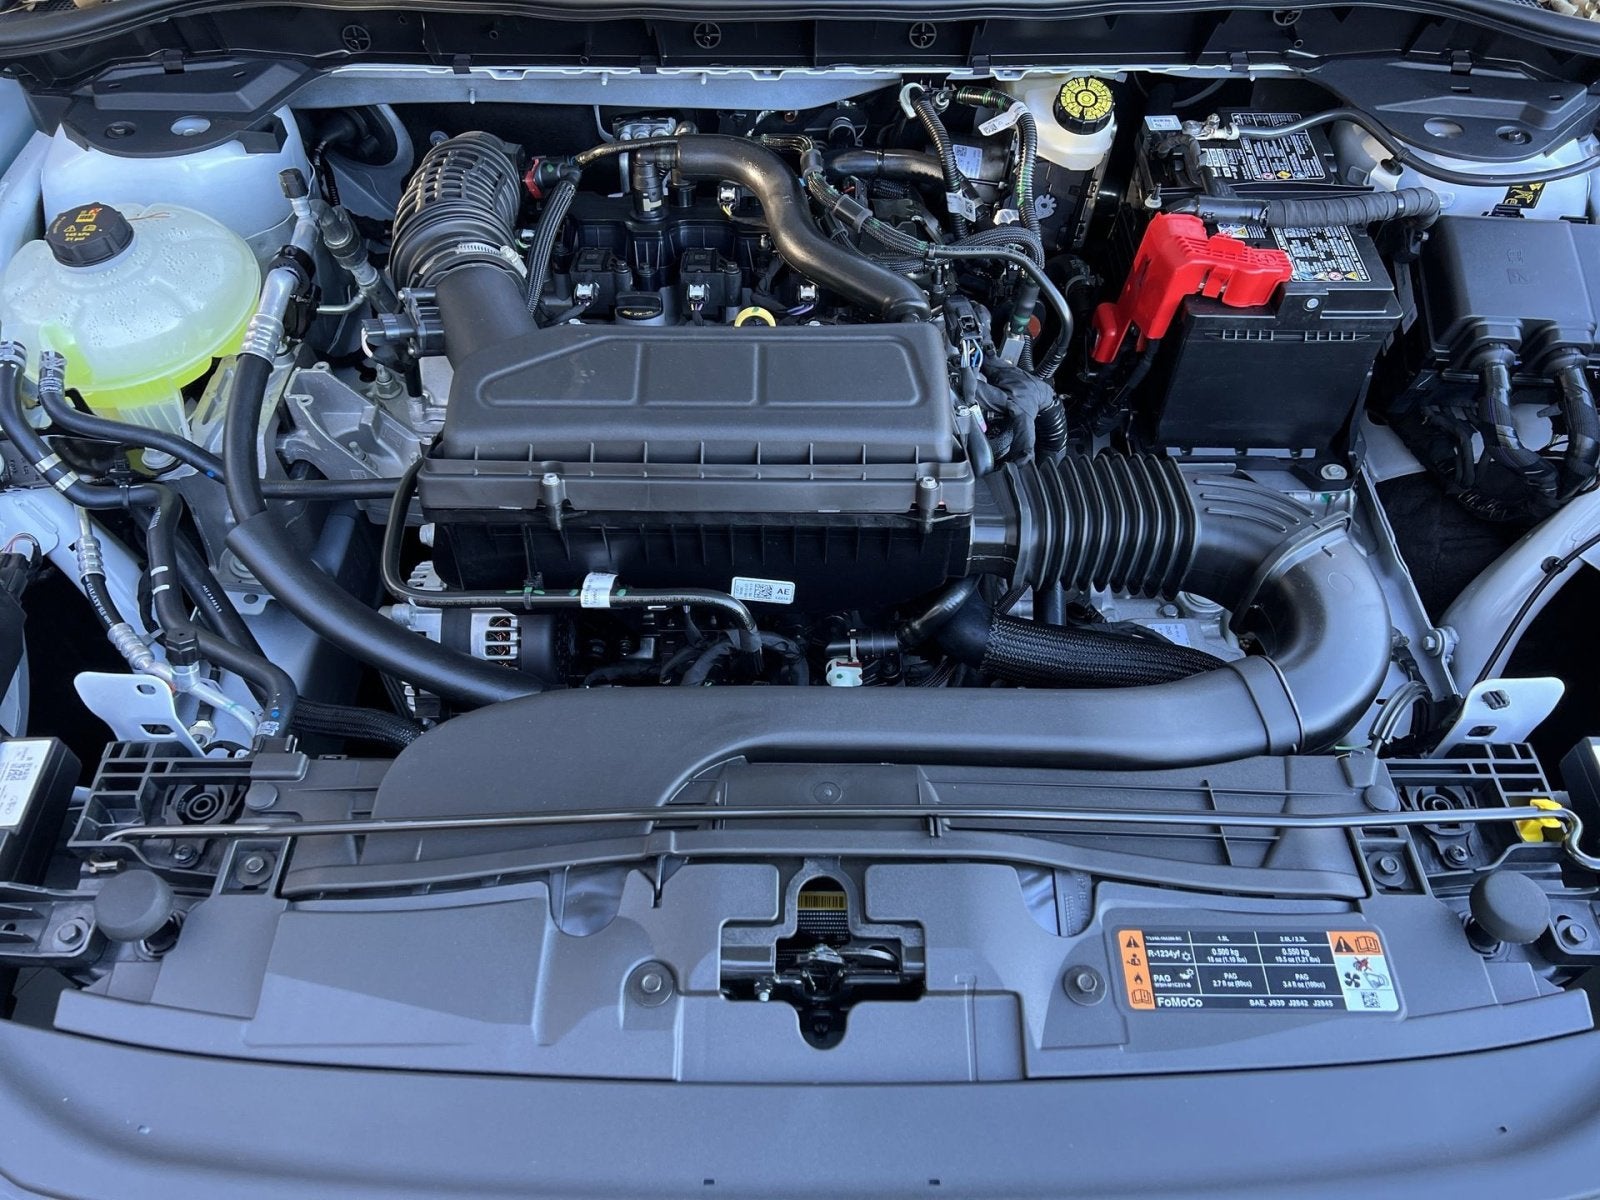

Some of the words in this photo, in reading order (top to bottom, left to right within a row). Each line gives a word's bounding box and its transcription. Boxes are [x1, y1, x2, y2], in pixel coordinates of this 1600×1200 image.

[86, 582, 102, 607] GALAXY
[777, 588, 791, 596] AE
[1147, 949, 1181, 959] R-1234yf
[1230, 948, 1240, 957] kg
[1300, 948, 1310, 957] kg
[1153, 974, 1172, 982] PAG
[1223, 972, 1238, 980] PAG
[1294, 973, 1310, 981] PAG
[1157, 997, 1204, 1008] FoMoCo
